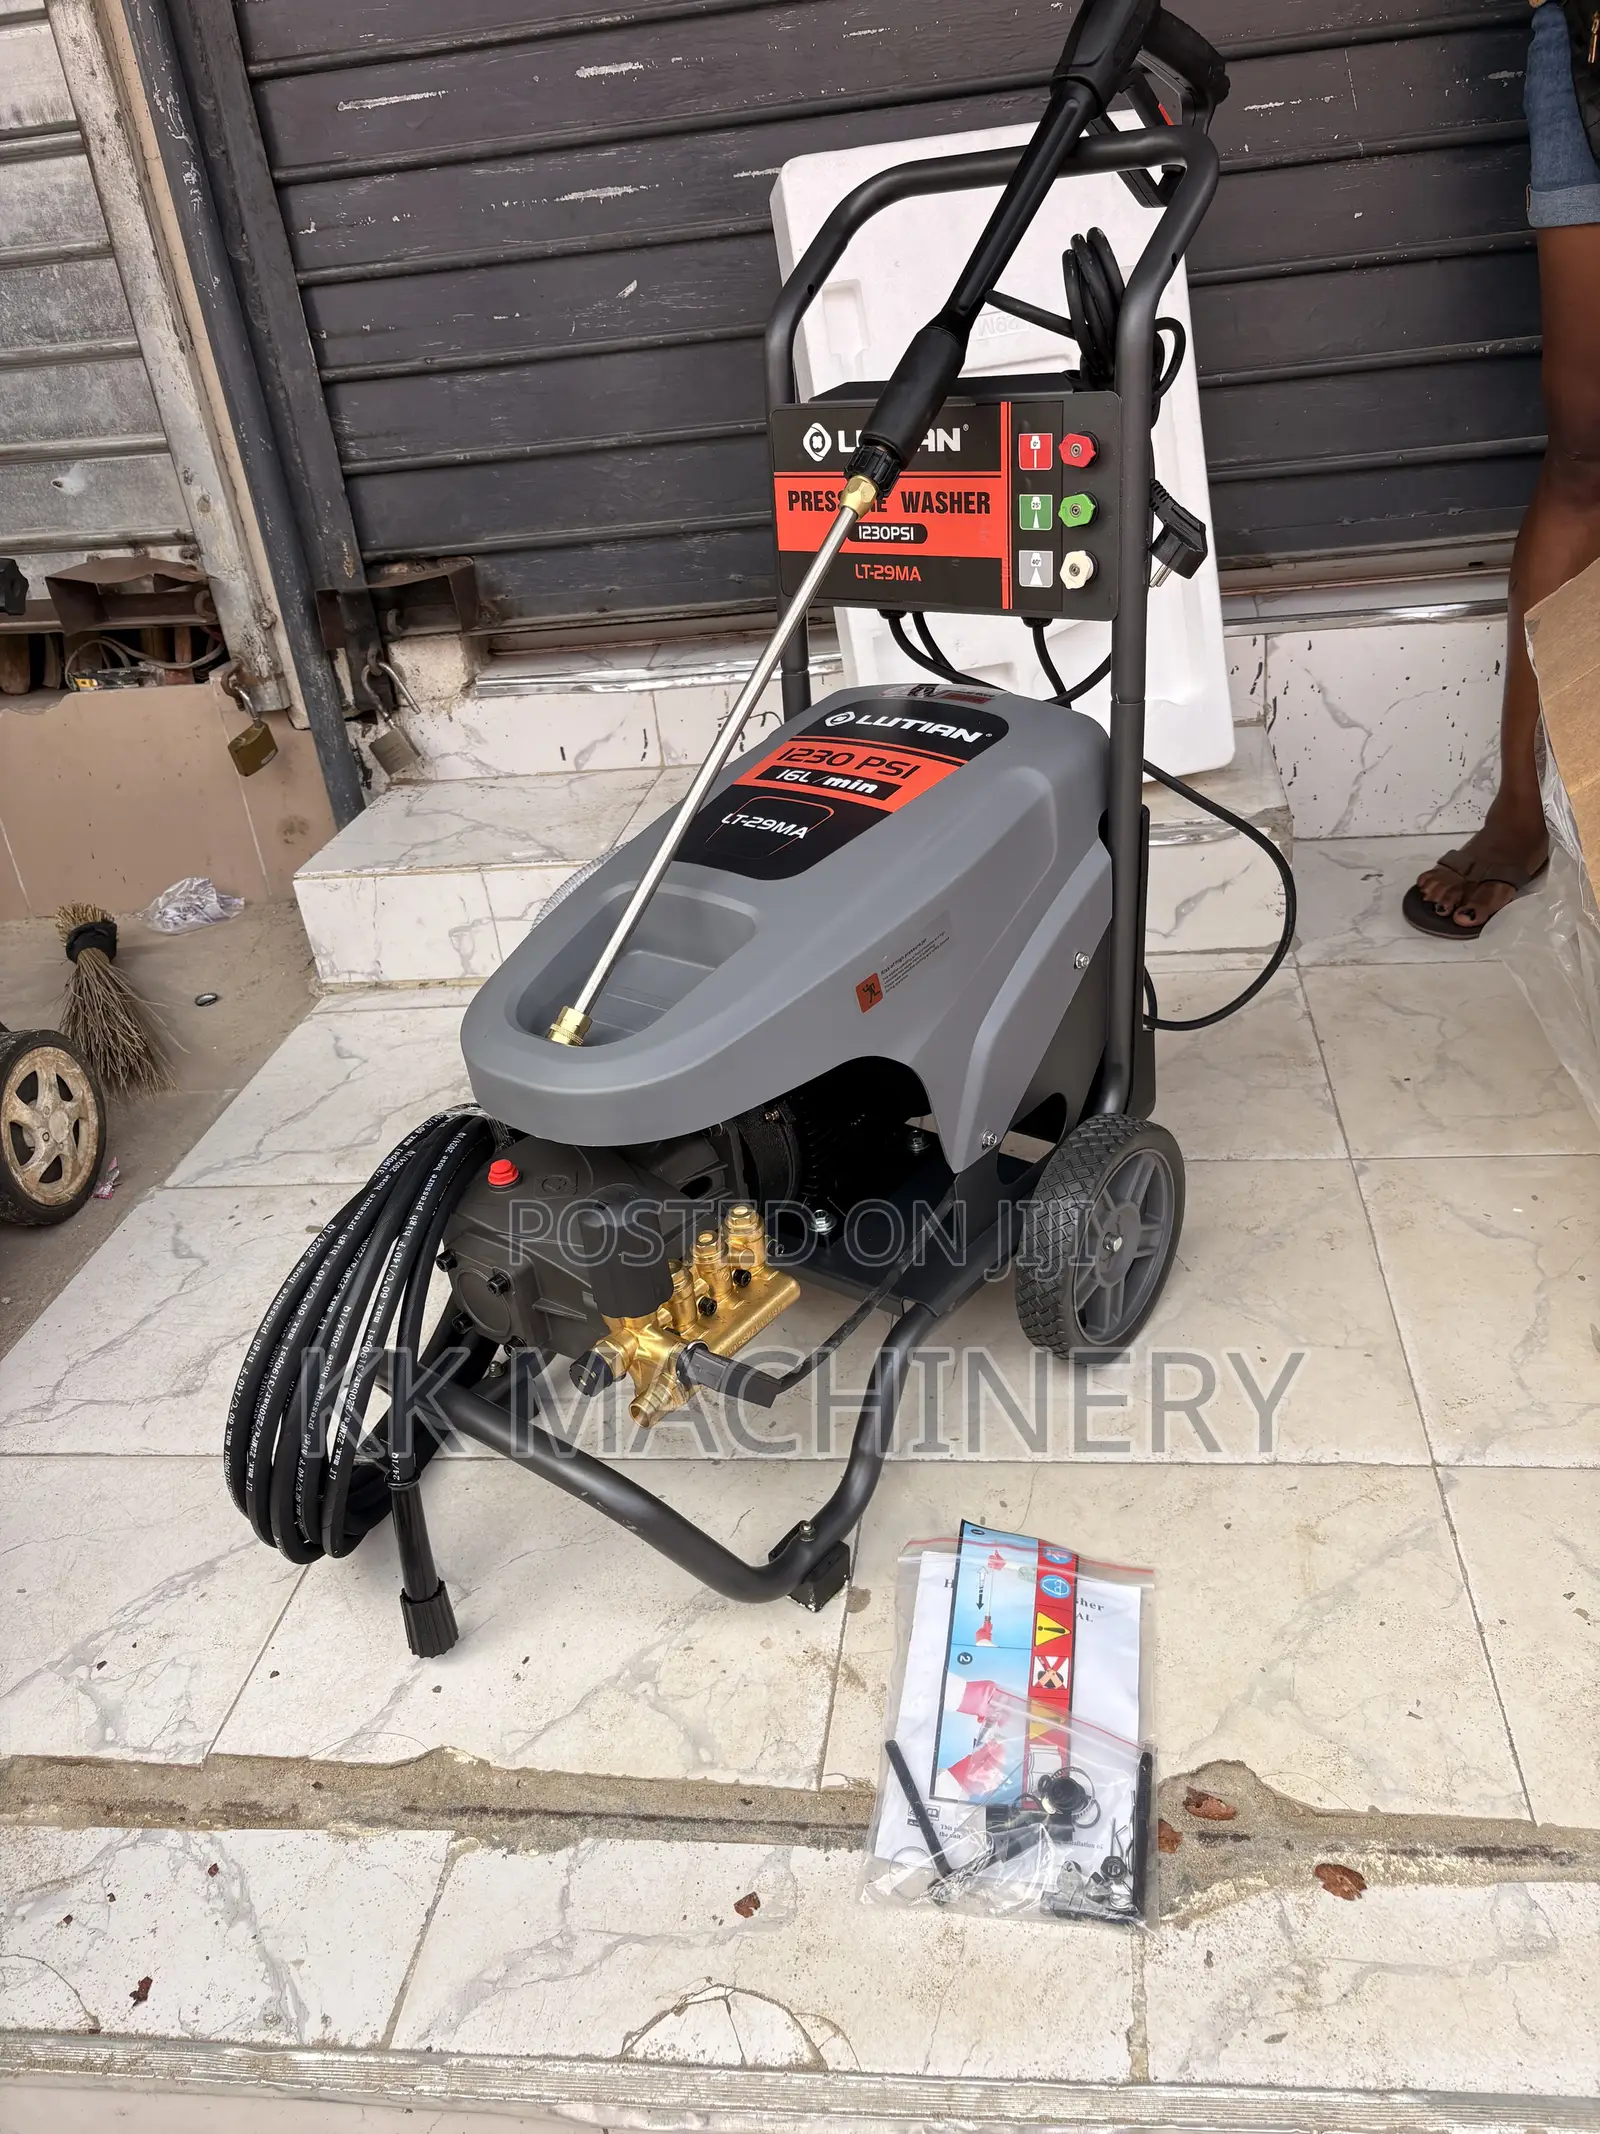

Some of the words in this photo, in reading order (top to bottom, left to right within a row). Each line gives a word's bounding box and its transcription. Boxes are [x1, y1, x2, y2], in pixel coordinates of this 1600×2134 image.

[788, 490, 888, 513] PRESE
[901, 491, 991, 514] WASHER
[858, 525, 914, 541] 1230PSI
[855, 563, 922, 582] LT-29MA
[855, 714, 983, 743] LUTIAN
[776, 748, 855, 766] 1230
[854, 756, 921, 780] PSI
[721, 813, 809, 839] LT-29MA
[328, 1232, 348, 1255] high
[347, 1191, 375, 1230] pressure
[374, 1174, 392, 1191] hose
[247, 1338, 262, 1362] high
[260, 1287, 288, 1333] pressure
[288, 1260, 306, 1283] hose
[317, 1317, 327, 1329] LT
[328, 1469, 337, 1479] LT
[403, 1213, 419, 1236] high
[415, 1173, 438, 1210] pressure
[434, 1154, 448, 1172] hose
[297, 1433, 313, 1454] high
[307, 1382, 324, 1428] pressure
[321, 1354, 333, 1377] hose
[330, 1305, 350, 1347] 2024/1Q
